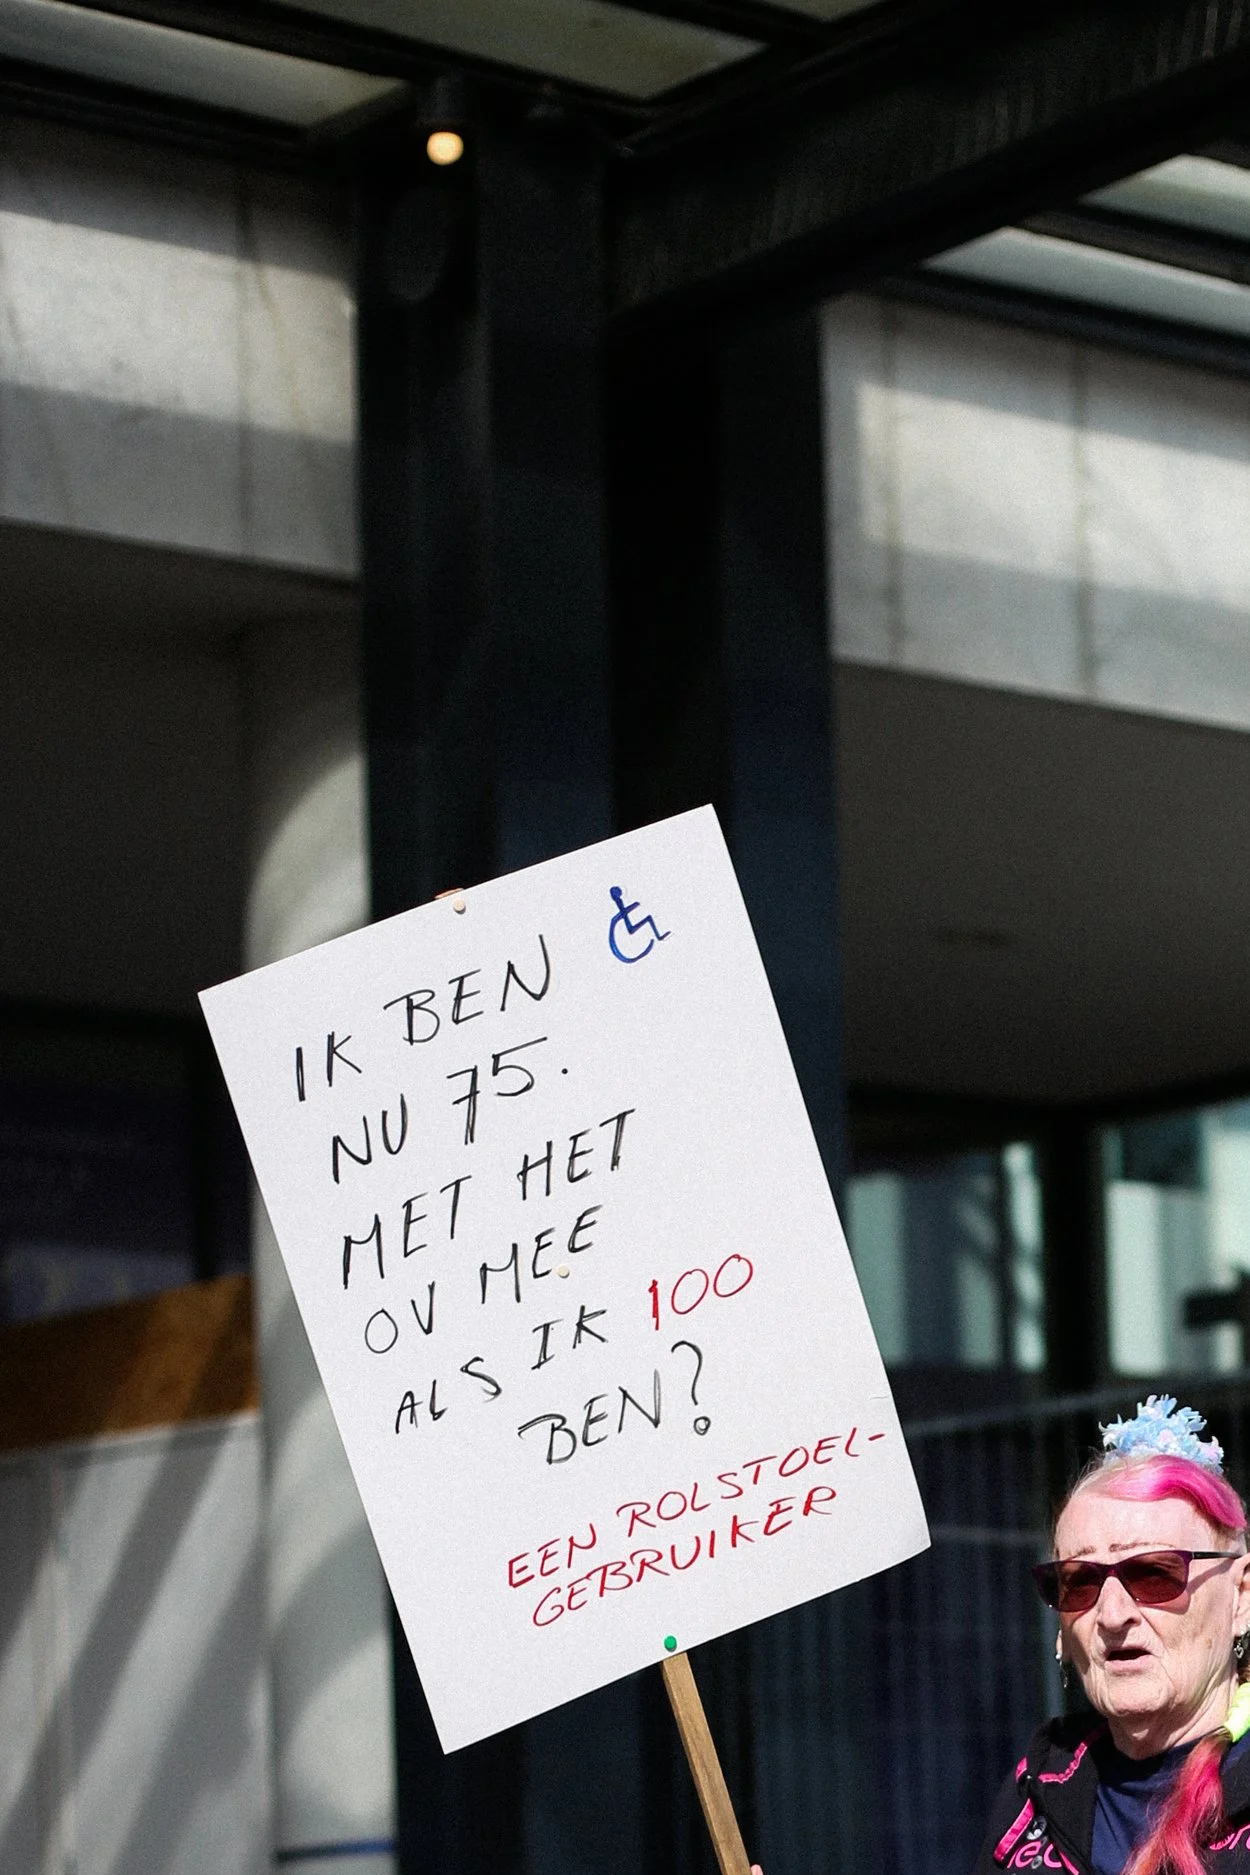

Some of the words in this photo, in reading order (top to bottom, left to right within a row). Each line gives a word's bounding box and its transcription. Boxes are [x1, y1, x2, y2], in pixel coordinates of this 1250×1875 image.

[295, 1031, 363, 1103] IK
[382, 934, 551, 1046] BEN
[331, 1093, 408, 1185] NU
[446, 1036, 570, 1146] 75.
[342, 1175, 472, 1290] MET
[516, 1108, 636, 1201] HET
[363, 1280, 436, 1355] OV
[479, 1205, 602, 1305] MEE
[394, 1356, 503, 1435] ALS
[530, 1304, 609, 1371] IK
[647, 1253, 754, 1331] 100
[517, 1340, 712, 1466] BEN?
[508, 1523, 599, 1589] EEN
[615, 1427, 886, 1538] ROLSTOEL-
[532, 1486, 838, 1627] GEBRUIKER
